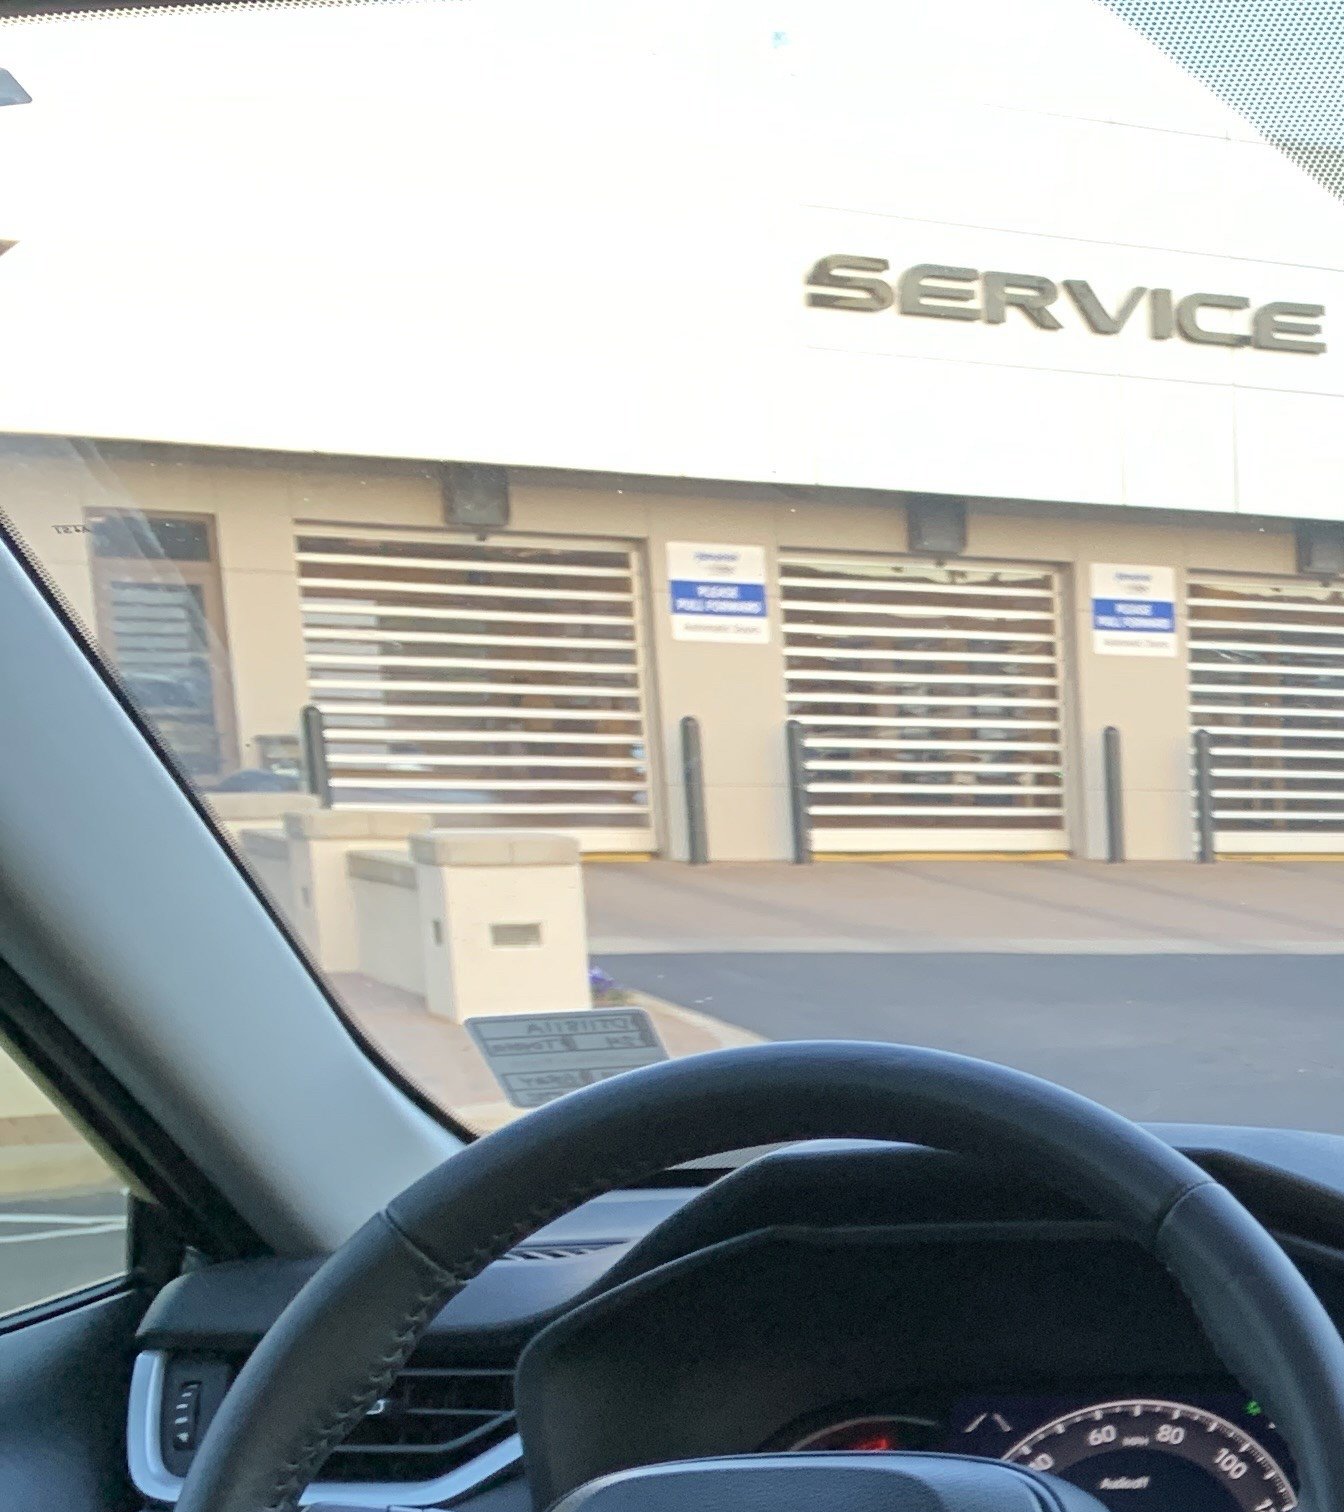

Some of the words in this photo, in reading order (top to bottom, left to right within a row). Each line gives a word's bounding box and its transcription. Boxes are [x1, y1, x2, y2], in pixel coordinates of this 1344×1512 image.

[803, 253, 1327, 354] SERVICE
[1088, 1424, 1117, 1446] 60
[1156, 1423, 1186, 1445] 80
[1215, 1447, 1249, 1481] 100
